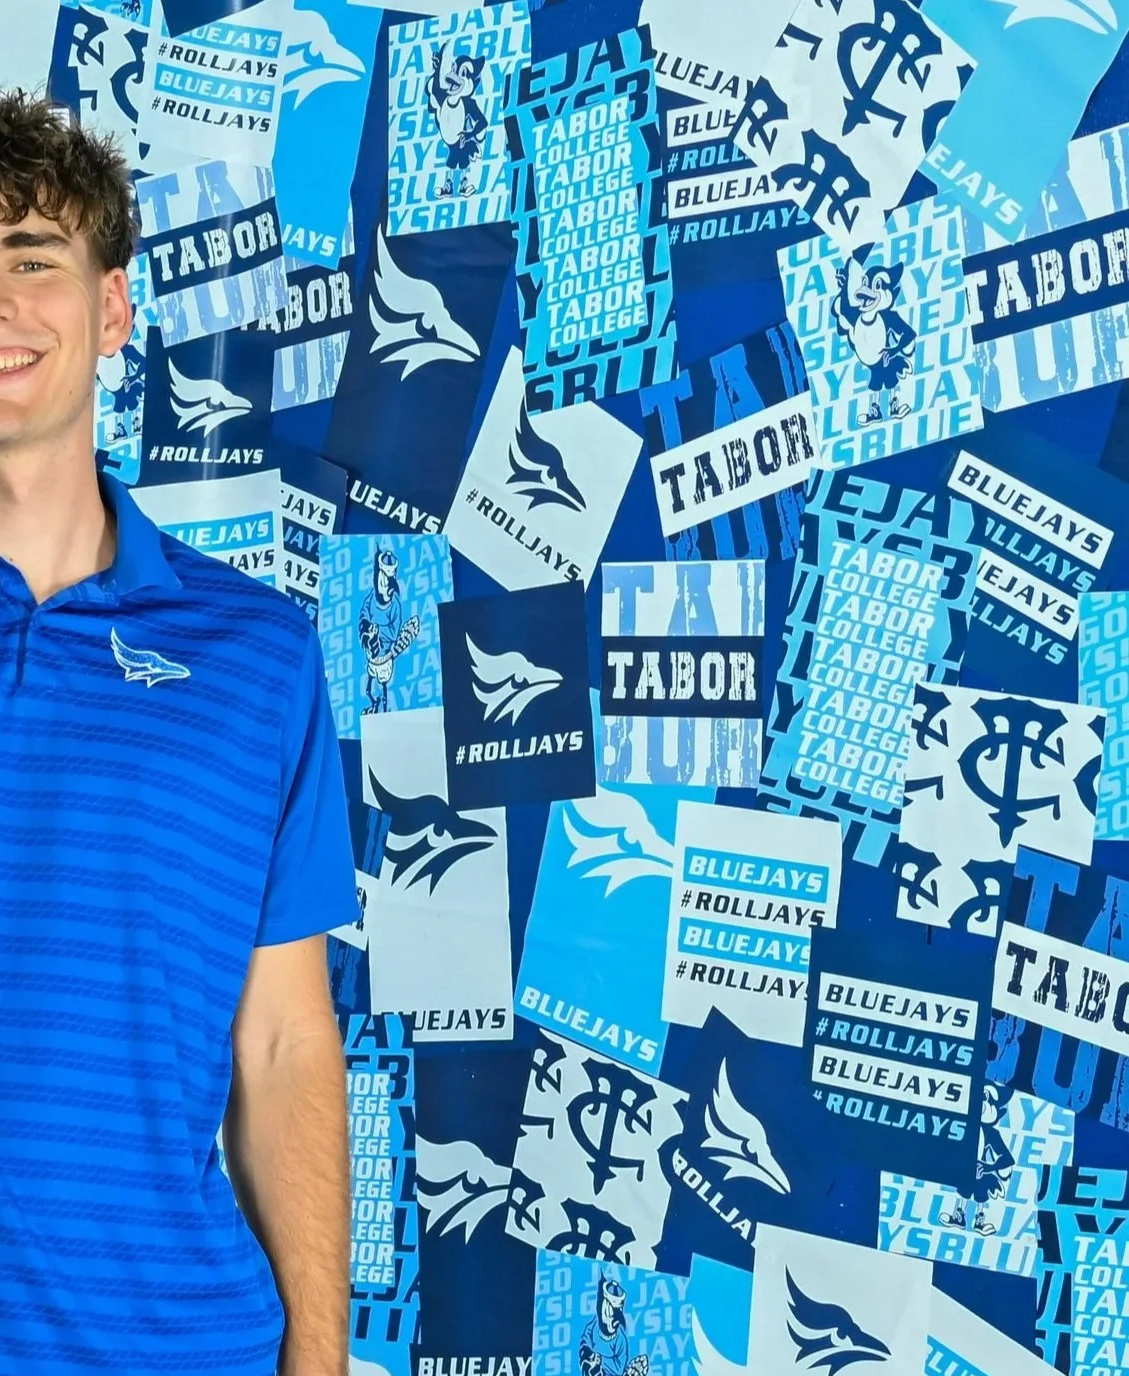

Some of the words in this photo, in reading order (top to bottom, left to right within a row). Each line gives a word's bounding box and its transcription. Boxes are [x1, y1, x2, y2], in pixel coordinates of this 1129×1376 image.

[158, 42, 278, 78] #ROLLJAYS
[184, 25, 278, 52] UEJAYS
[158, 70, 272, 106] BLUEJAYS
[652, 49, 754, 99] LUEJA
[151, 96, 271, 132] #ROLLJAYS
[532, 96, 628, 150] TABOR
[535, 122, 630, 170] COLLEGE
[536, 142, 632, 194] TABOR
[539, 167, 634, 214] COLLEGE
[540, 187, 636, 239] TABOR
[151, 210, 279, 283] TABOR
[542, 212, 638, 259] COLLEGE
[544, 233, 641, 284] TABOR
[547, 258, 643, 303] COLLEGE
[547, 279, 644, 328] TABOR
[550, 307, 646, 348] COLLEGE
[149, 446, 264, 465] #ROLLJAYS
[660, 409, 815, 515] TABOR
[958, 463, 1104, 554] BLUEJAYS
[465, 488, 582, 581] #ROLLJAYS
[826, 568, 938, 611] COLLEGE
[831, 540, 943, 592] TABOR
[822, 588, 934, 639] TABOR
[814, 636, 927, 684] TABOR
[818, 615, 929, 660] COLLEGE
[607, 651, 757, 701] TABOR
[455, 731, 583, 765] #ROLLJAYS
[799, 730, 908, 777] TABOR
[803, 708, 910, 754] COLLEGE
[793, 756, 905, 806] COLLEGE
[688, 855, 824, 893] BLUEJAYS
[680, 889, 825, 928] #ROLLJAYS
[675, 959, 809, 1002] #ROLLJAY
[520, 986, 659, 1063] BLUEJAYS
[825, 984, 970, 1028] BLUEJAYS
[816, 1017, 974, 1066] #ROLLJAYS
[820, 1056, 963, 1102] BLUEJAYS
